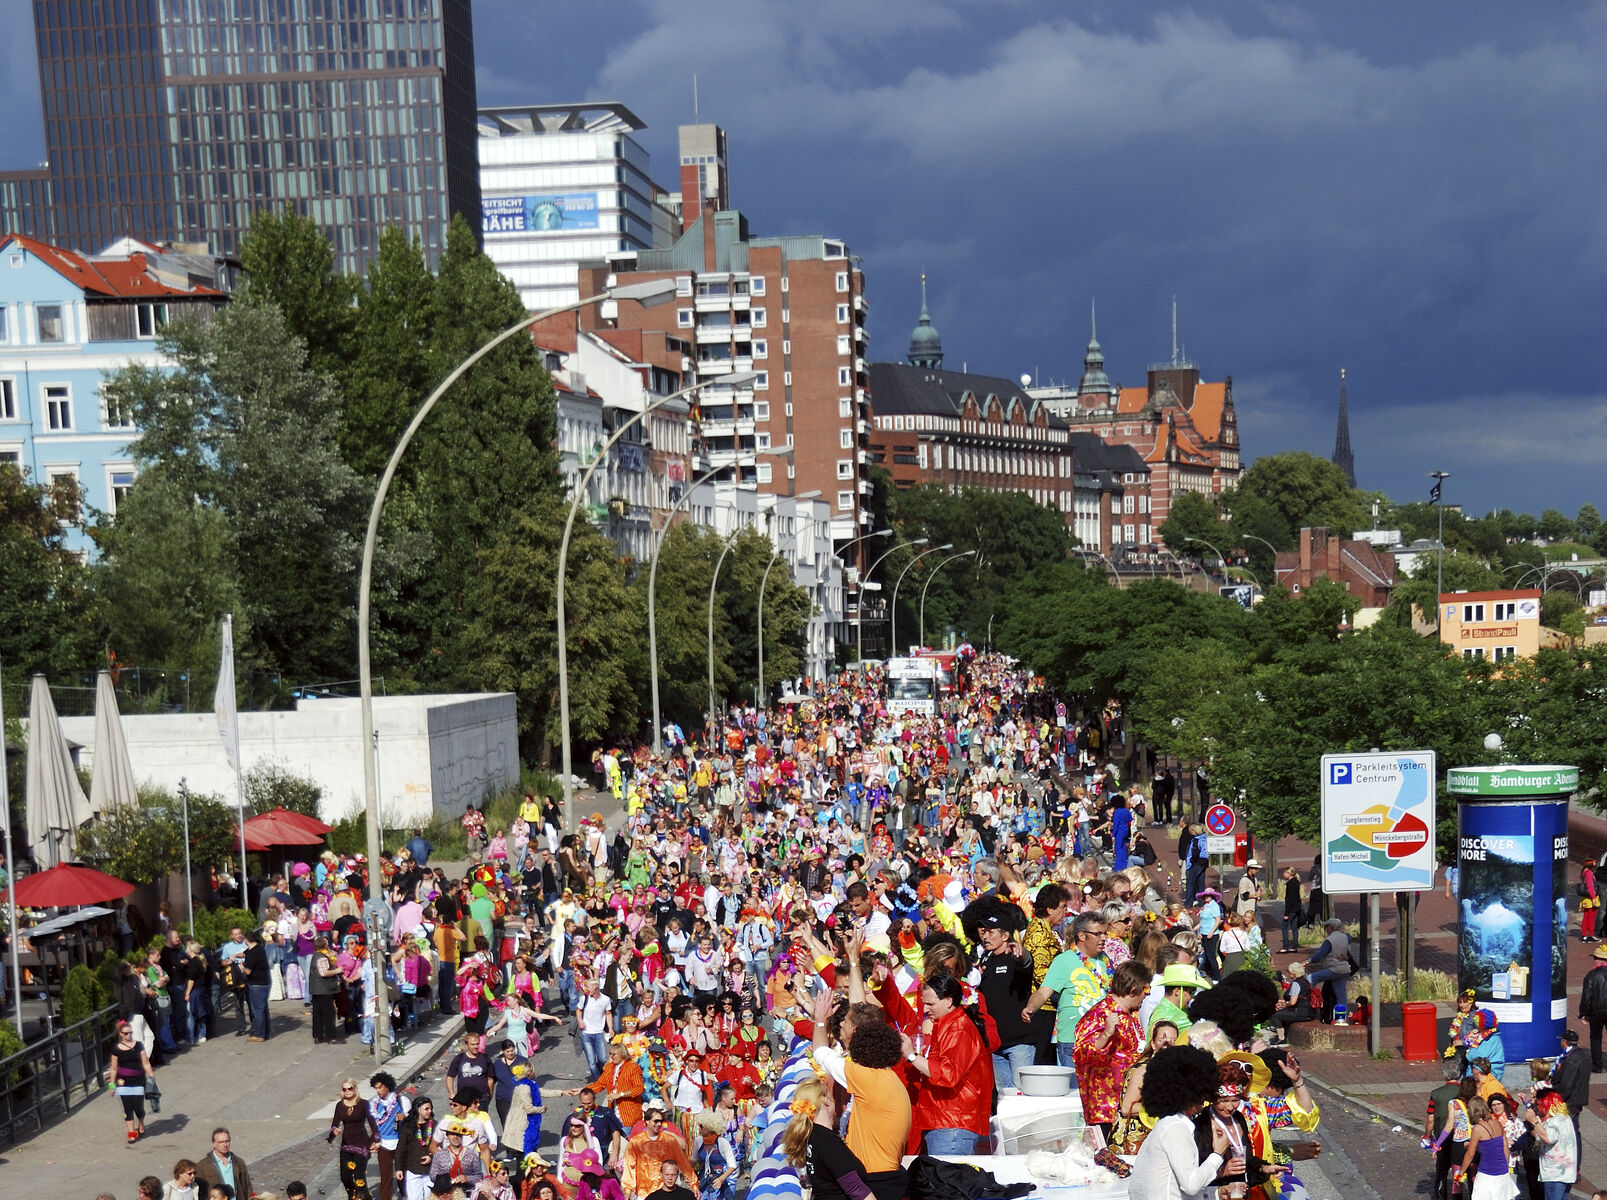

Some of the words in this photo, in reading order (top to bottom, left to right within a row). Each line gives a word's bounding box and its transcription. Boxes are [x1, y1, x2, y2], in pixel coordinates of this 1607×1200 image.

[1473, 628, 1517, 638] StrandPauli
[1356, 762, 1427, 772] Parkleitsystem
[1356, 775, 1397, 783] Centrum
[1490, 775, 1552, 788] Hamburger
[1344, 816, 1381, 824] Jungfernstieg
[1461, 838, 1514, 850] DISCOVER
[1461, 850, 1486, 860] MORE
